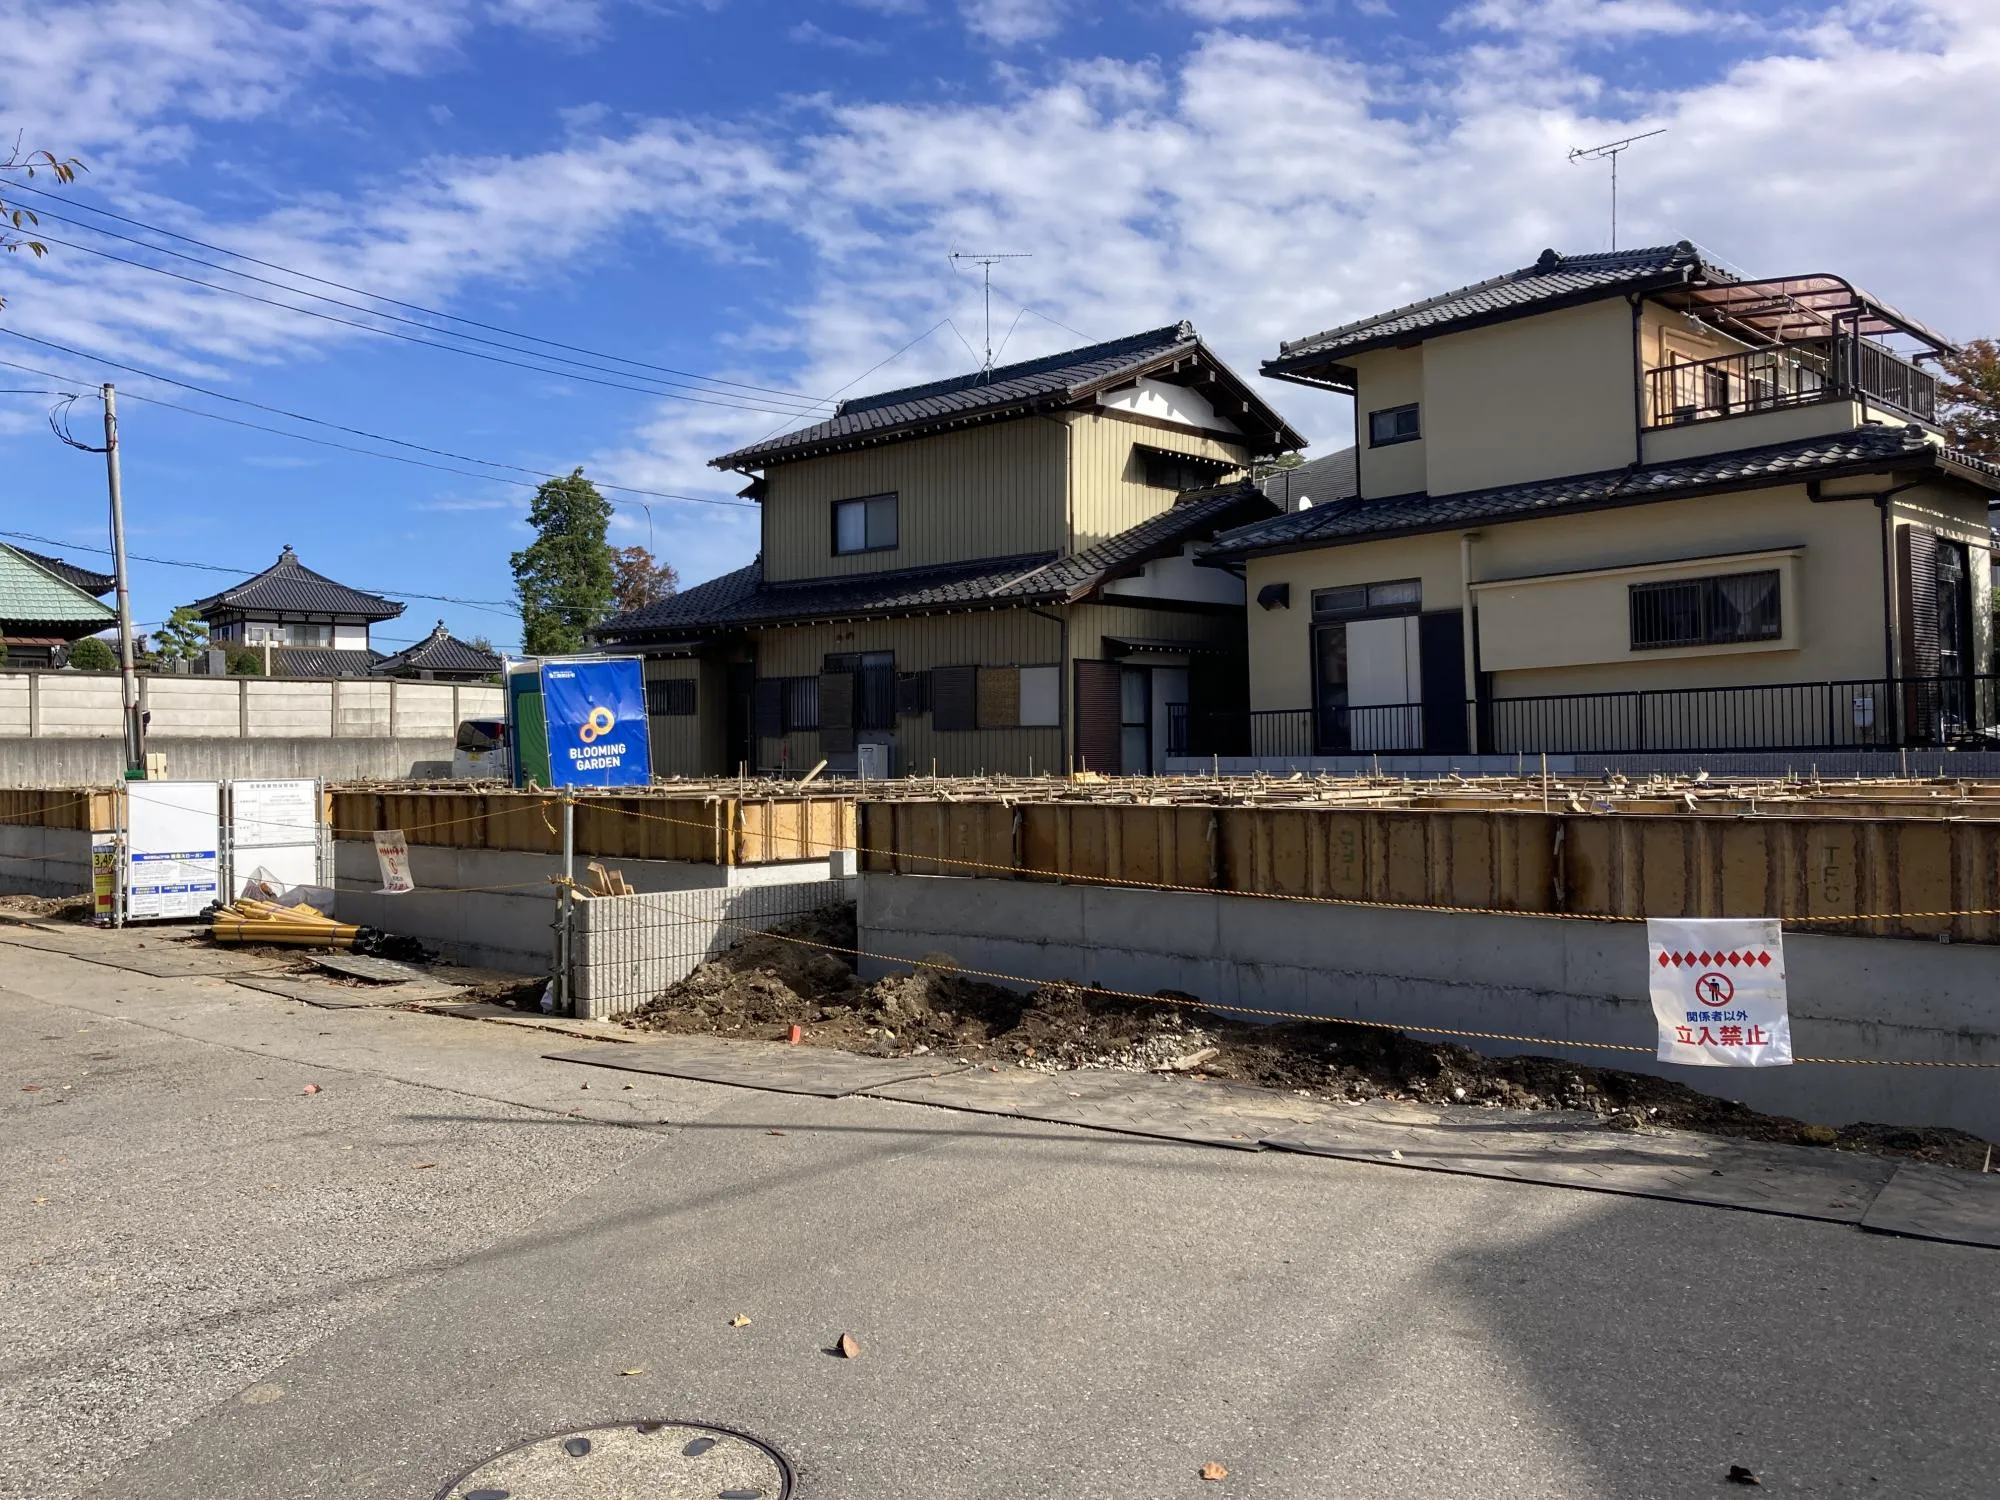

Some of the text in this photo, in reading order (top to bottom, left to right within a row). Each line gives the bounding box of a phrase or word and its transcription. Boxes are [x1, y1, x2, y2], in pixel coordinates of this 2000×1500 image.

[569, 744, 626, 759] BLOOMING
[577, 756, 621, 771] GARDEN
[1686, 1010, 1749, 1023] 関係者以外
[1675, 1024, 1769, 1047] 立入禁止
